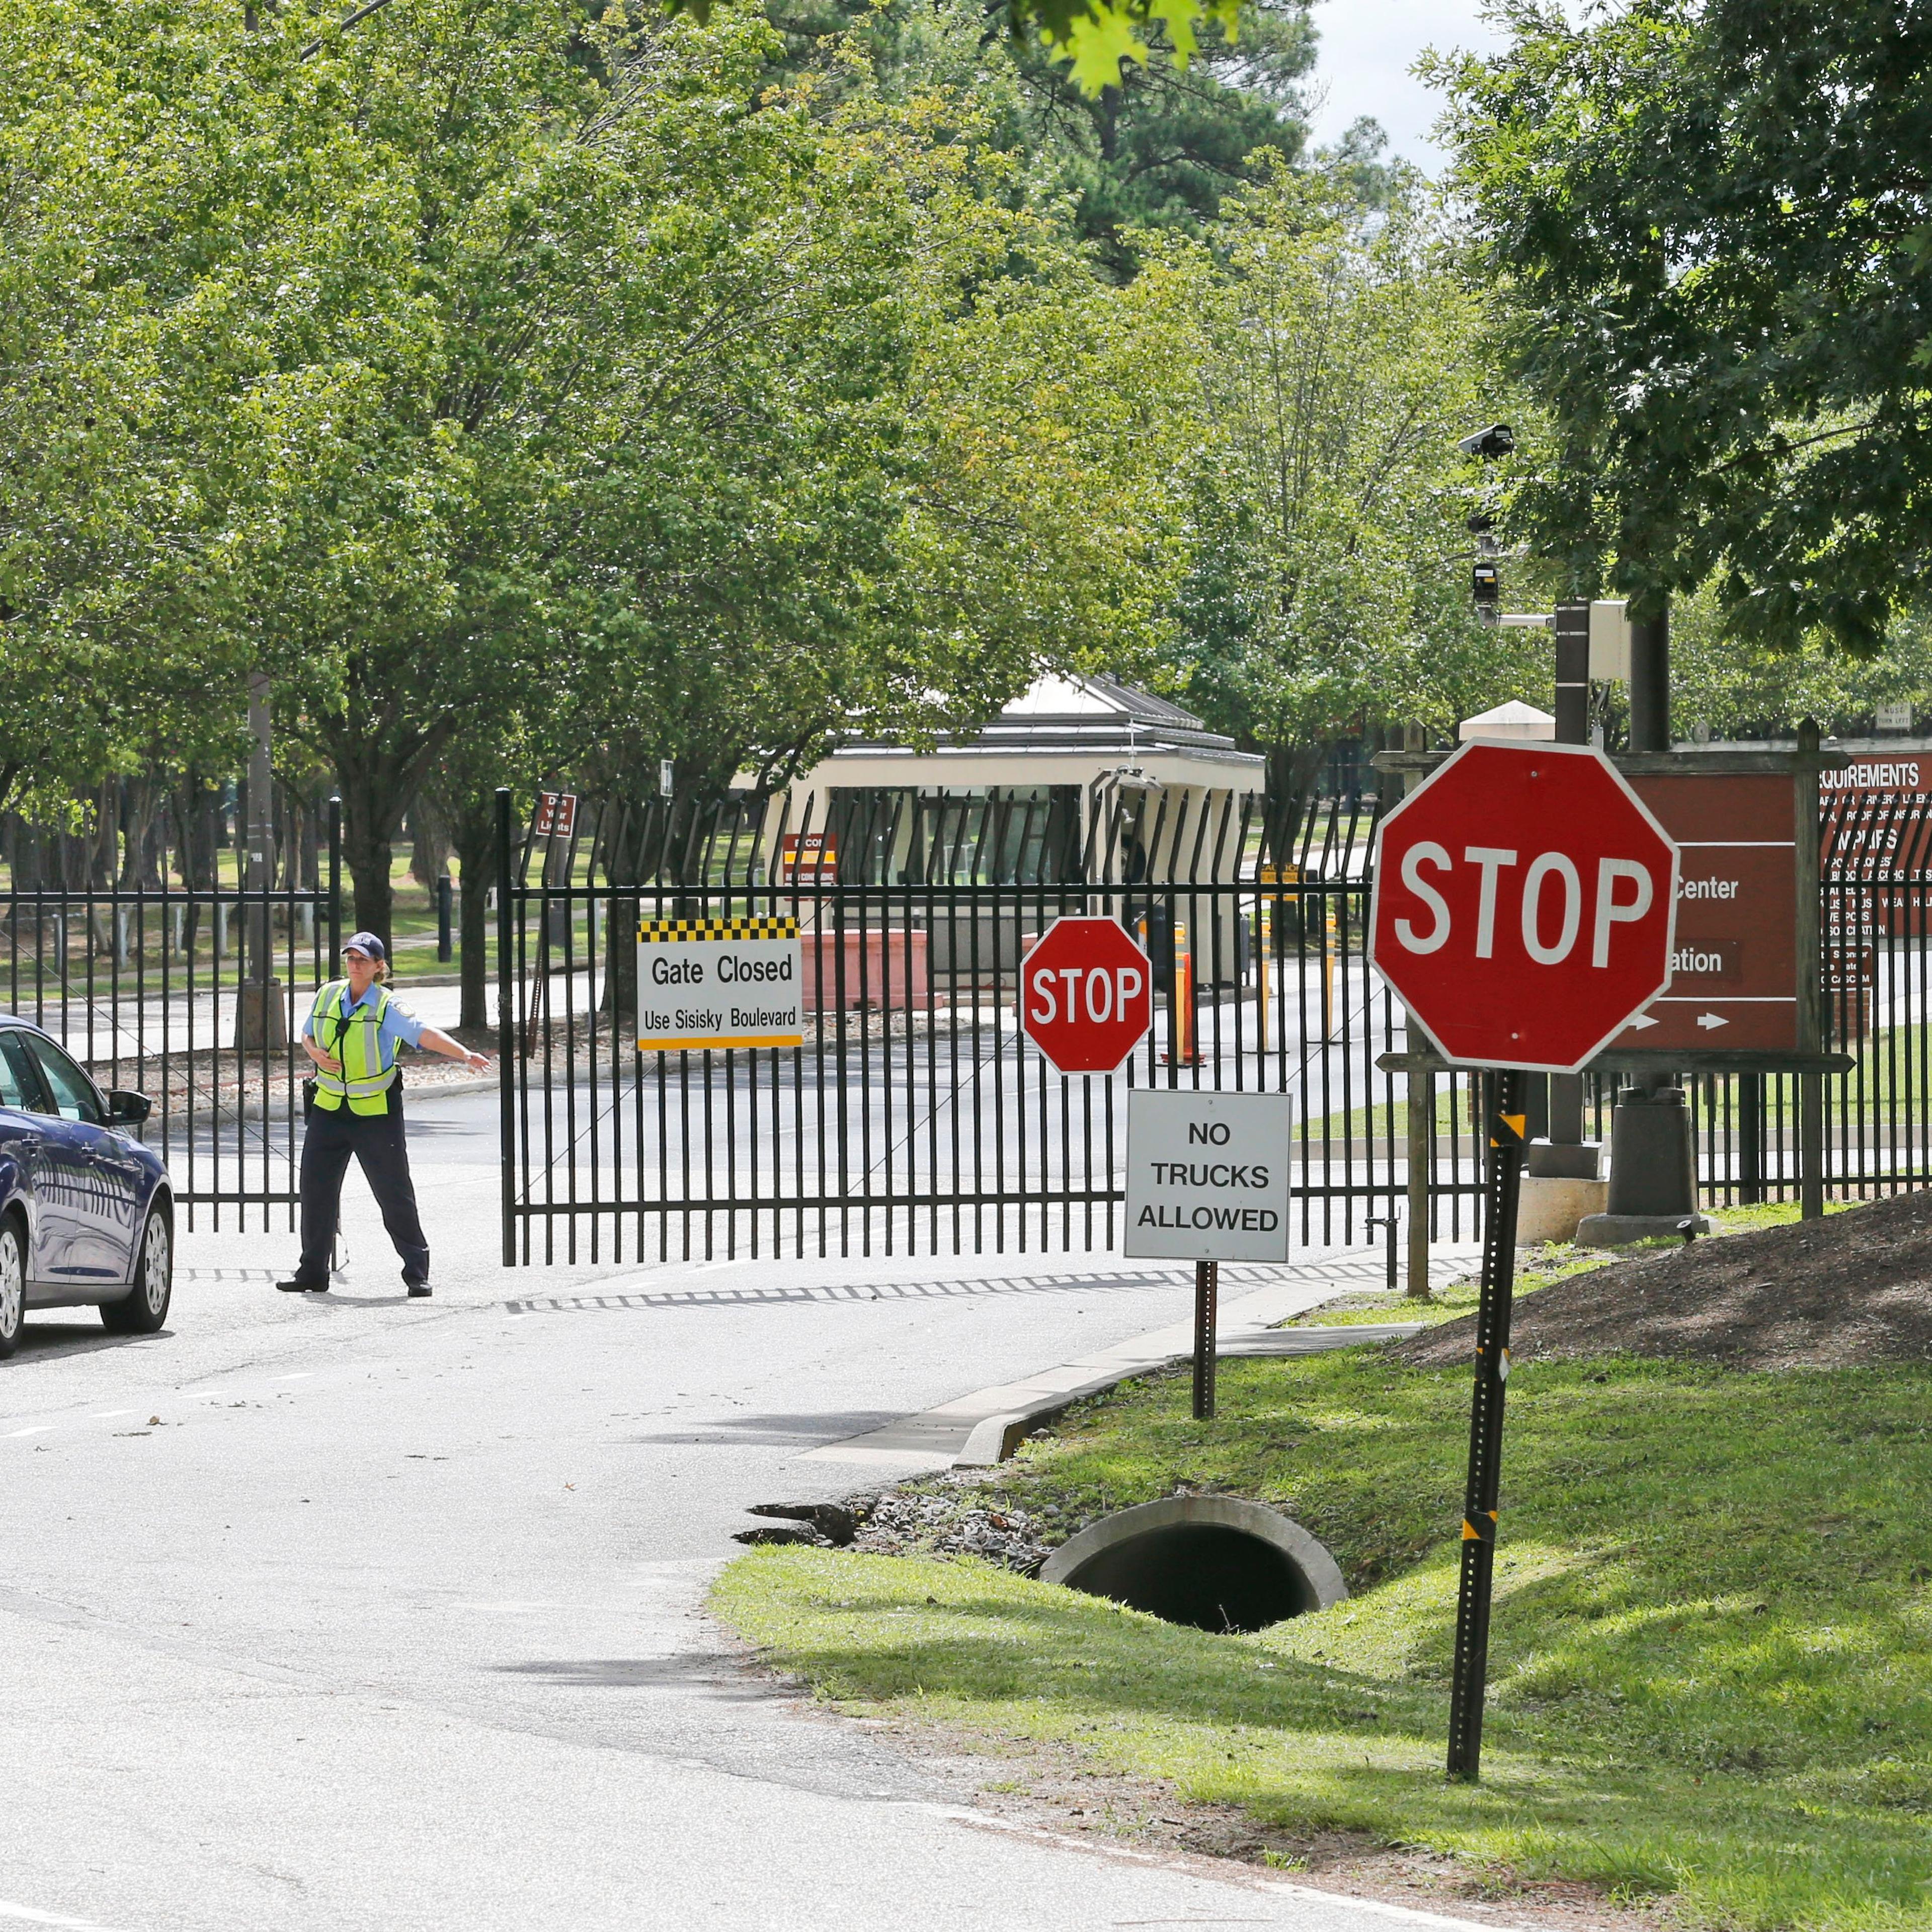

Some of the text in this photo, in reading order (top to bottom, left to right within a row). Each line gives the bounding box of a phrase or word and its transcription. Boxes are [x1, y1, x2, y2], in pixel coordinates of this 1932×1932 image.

[1395, 841, 1653, 968] STOP
[653, 954, 791, 985] Gate Closed
[1031, 968, 1142, 1024] STOP
[646, 1006, 795, 1031] Use Sisisky Boulevard
[1189, 1123, 1230, 1145] NO
[1151, 1163, 1268, 1188] TRUCKS
[1138, 1205, 1278, 1231] ALLOWED
